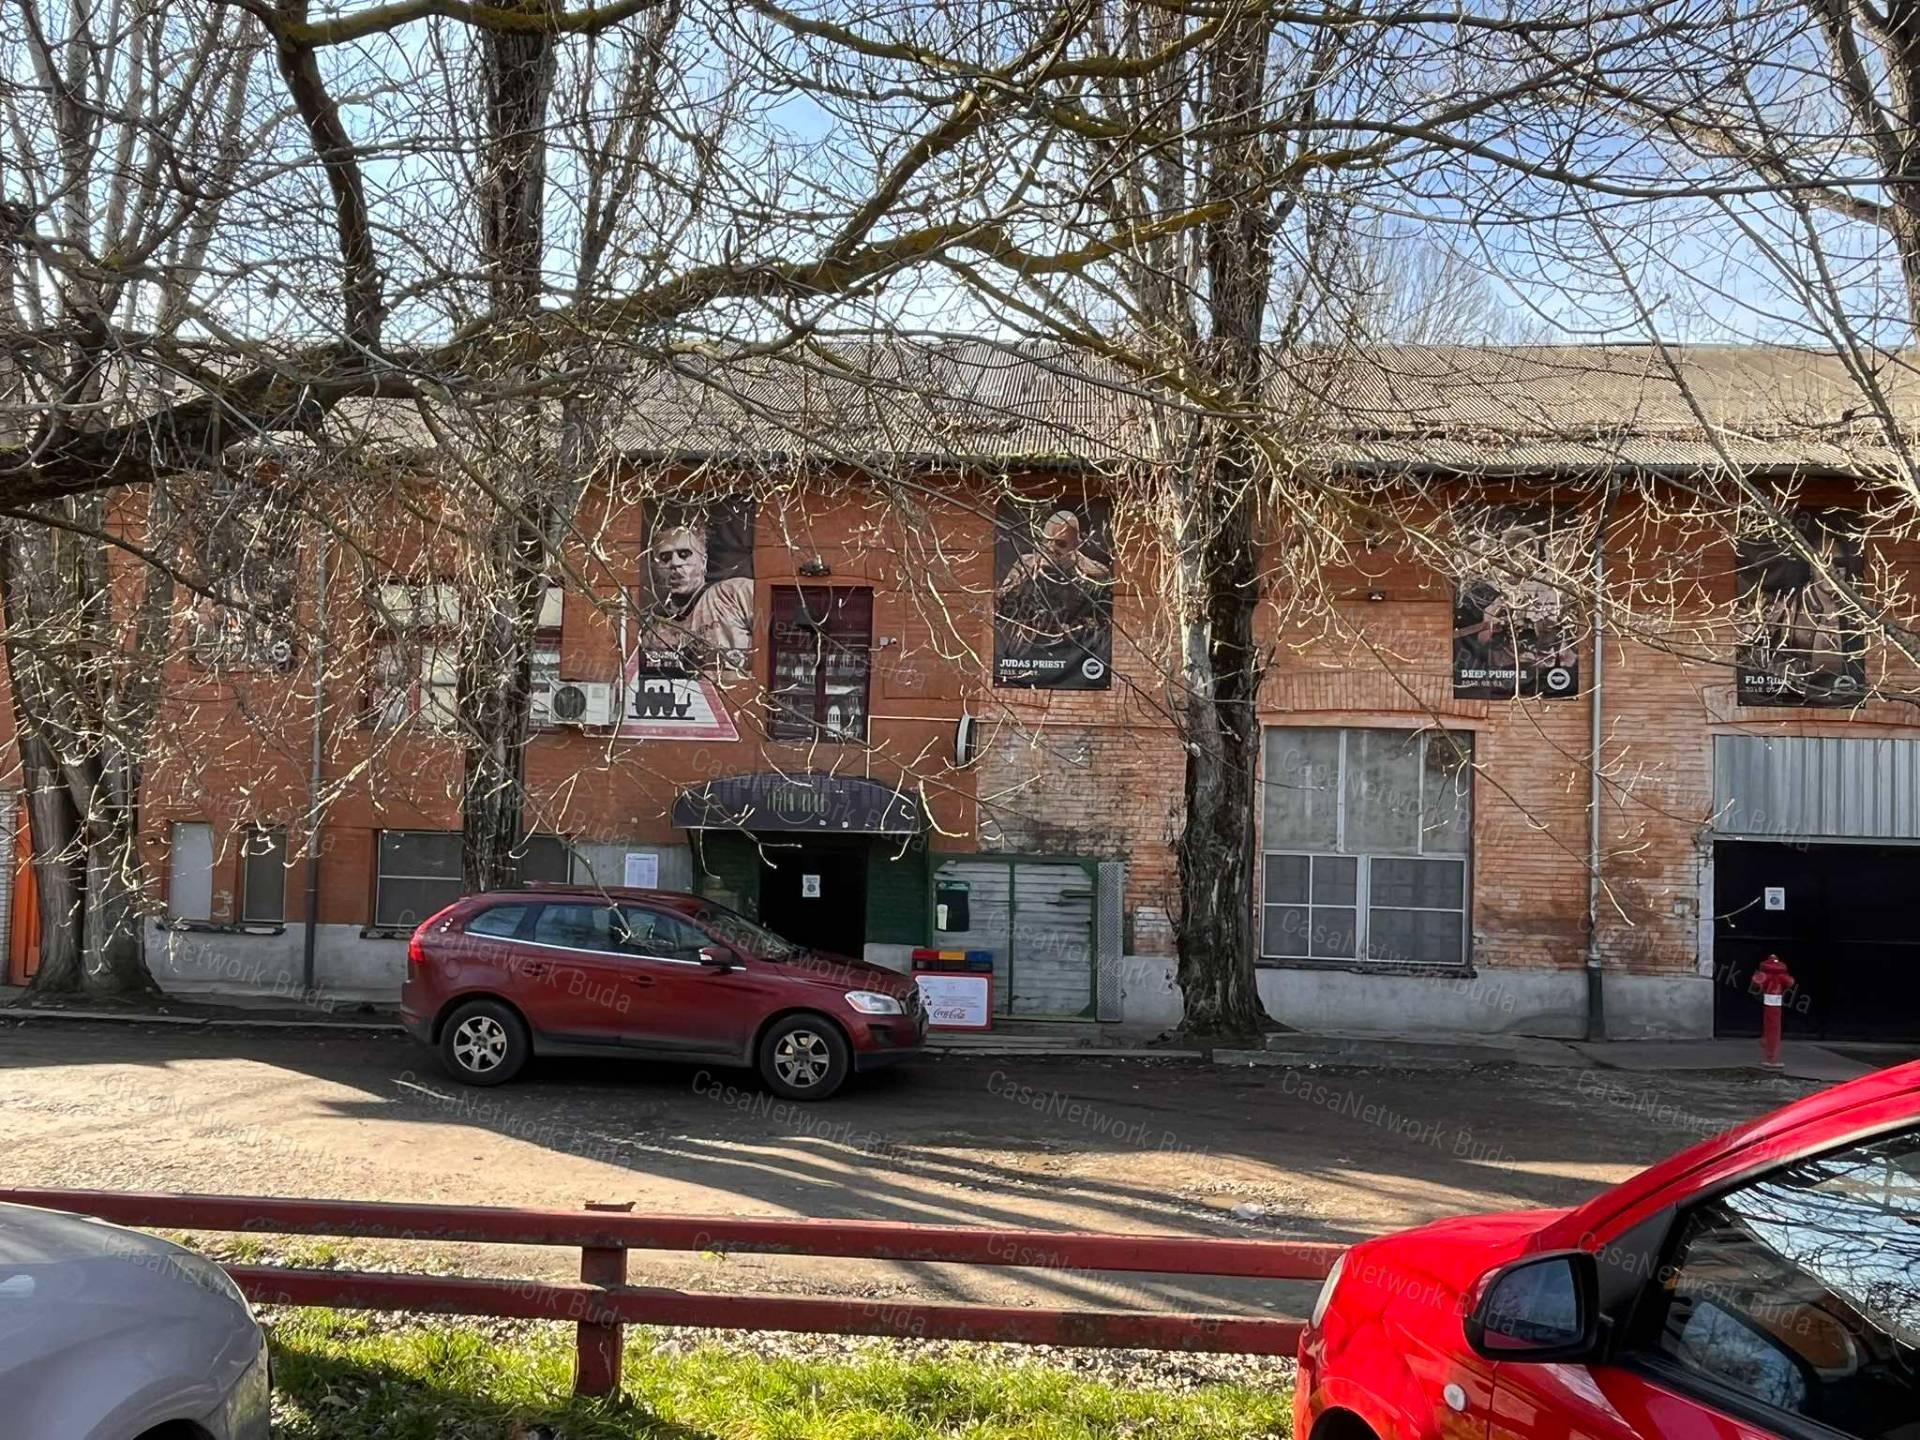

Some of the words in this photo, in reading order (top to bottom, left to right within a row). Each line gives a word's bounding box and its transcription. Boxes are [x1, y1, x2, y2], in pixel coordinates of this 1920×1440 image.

[1000, 659, 1030, 668] JUDAS
[1032, 660, 1066, 669] PRIEST
[1461, 670, 1486, 678] DEEP
[1488, 670, 1527, 679] PURPE
[1745, 676, 1764, 684] FLO
